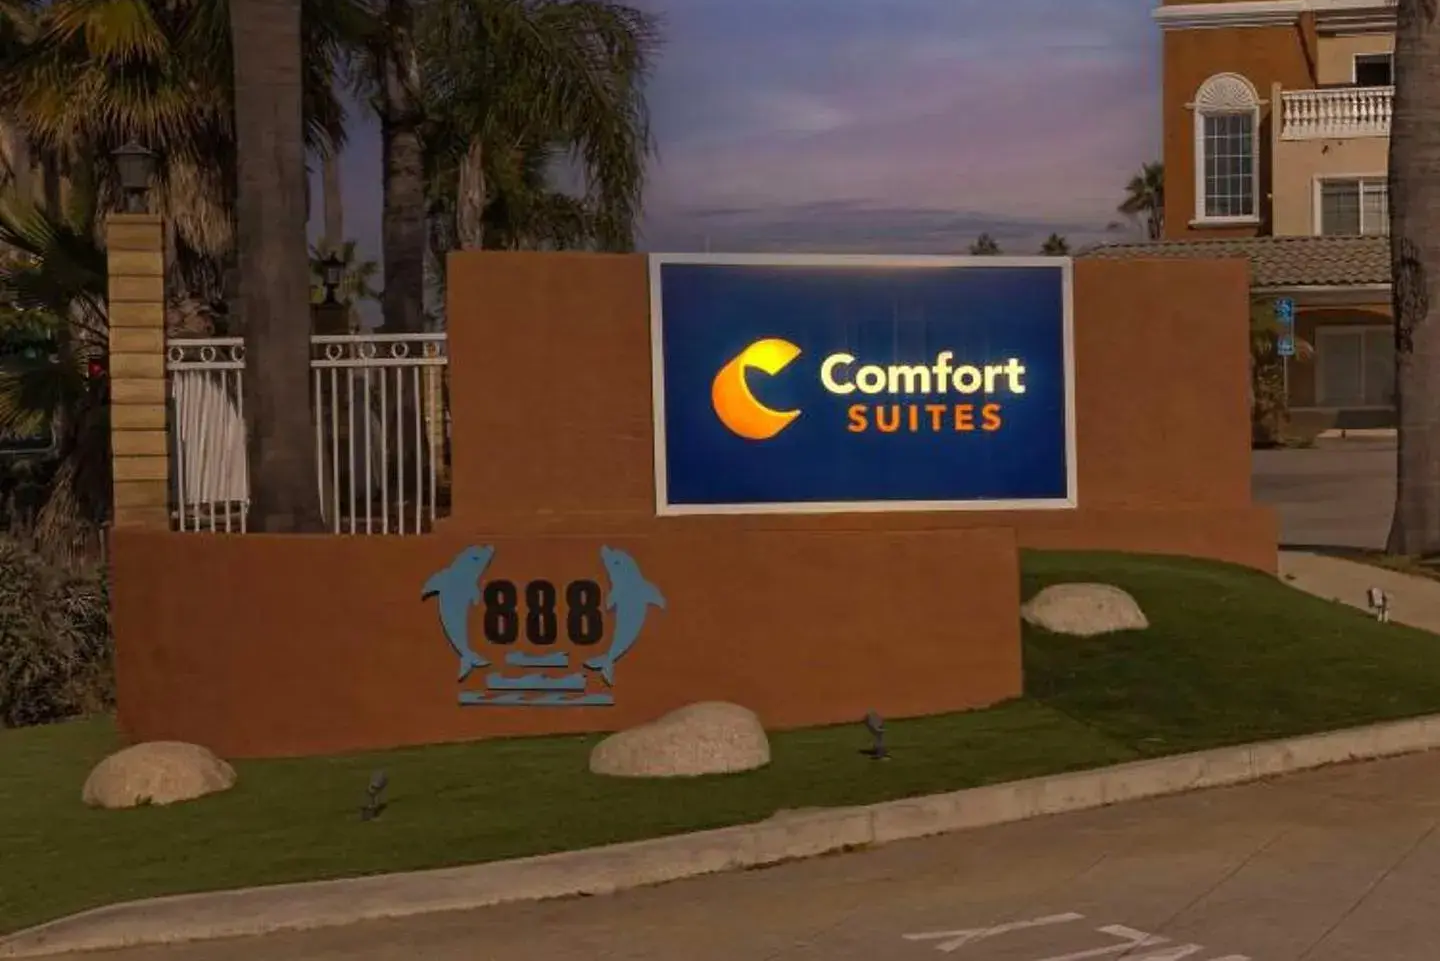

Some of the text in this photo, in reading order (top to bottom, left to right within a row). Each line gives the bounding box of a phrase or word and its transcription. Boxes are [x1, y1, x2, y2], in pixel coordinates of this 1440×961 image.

[821, 351, 1025, 394] Comfort
[849, 403, 1001, 432] SUITES
[484, 581, 602, 644] 888
